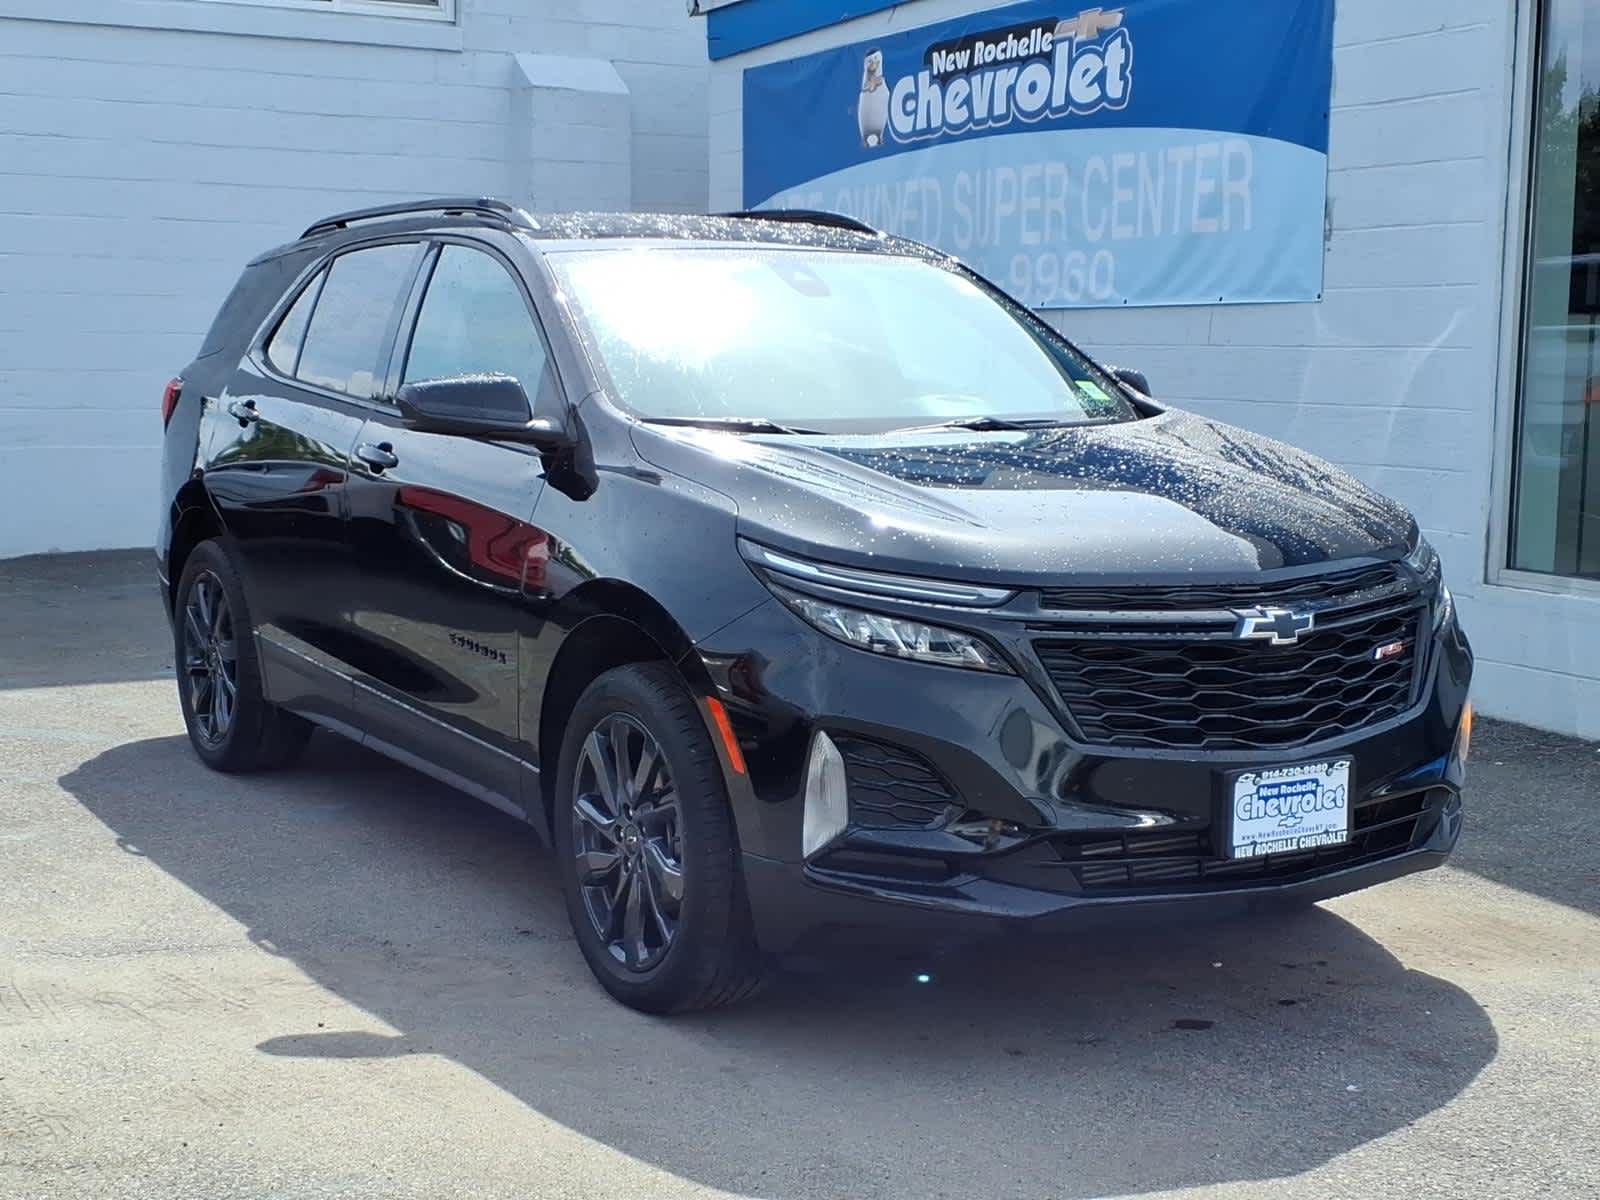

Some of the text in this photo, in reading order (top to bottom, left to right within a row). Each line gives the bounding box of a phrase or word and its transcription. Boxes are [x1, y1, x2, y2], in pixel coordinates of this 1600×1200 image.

[931, 27, 1053, 75] New Rochelle
[889, 33, 1129, 136] Chevrolet
[953, 161, 1070, 250] SUPER
[1081, 138, 1254, 242] CENTER
[1236, 784, 1346, 821] Chevrolet
[1259, 781, 1317, 797] New Rochelle
[1234, 831, 1348, 858] NEW ROCHELLE CHEVROLET
